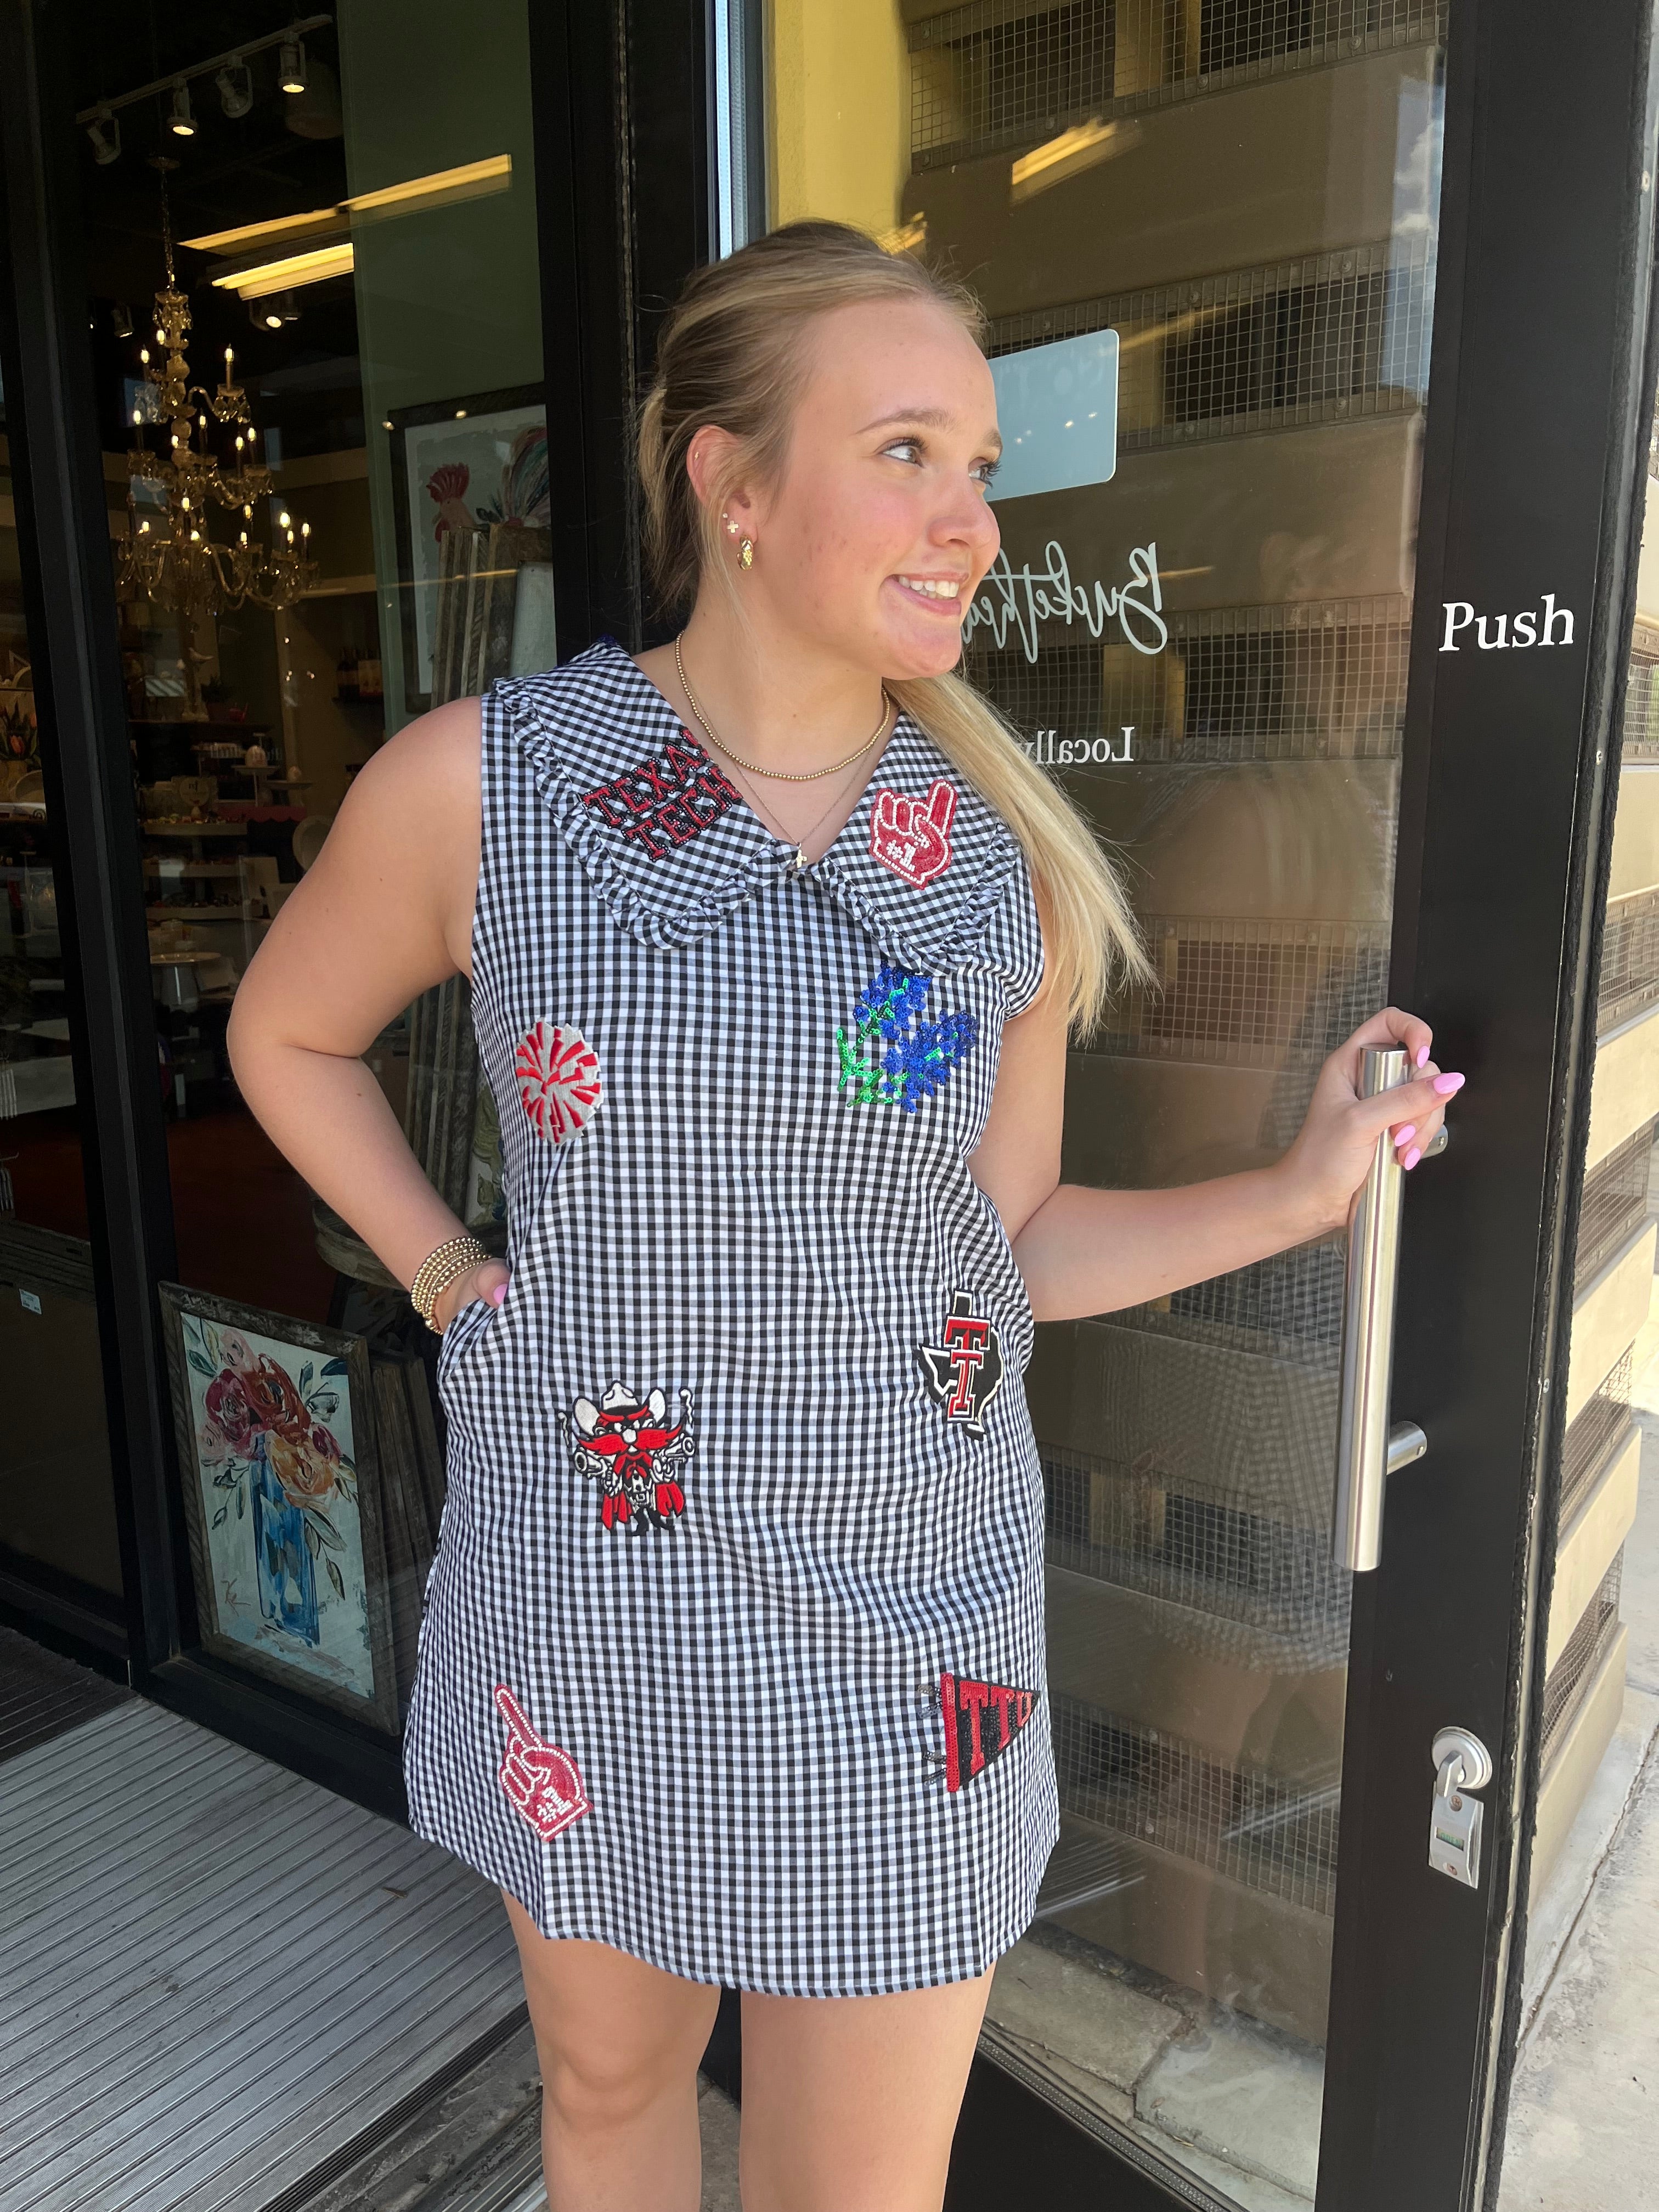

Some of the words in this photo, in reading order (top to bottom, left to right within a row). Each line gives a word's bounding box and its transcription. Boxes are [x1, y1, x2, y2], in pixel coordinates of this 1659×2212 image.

[1438, 593, 1574, 652] Push
[623, 763, 743, 862] TECH
[886, 839, 917, 872] #1
[959, 1680, 1032, 1775] TTU
[537, 1786, 574, 1823] #1
